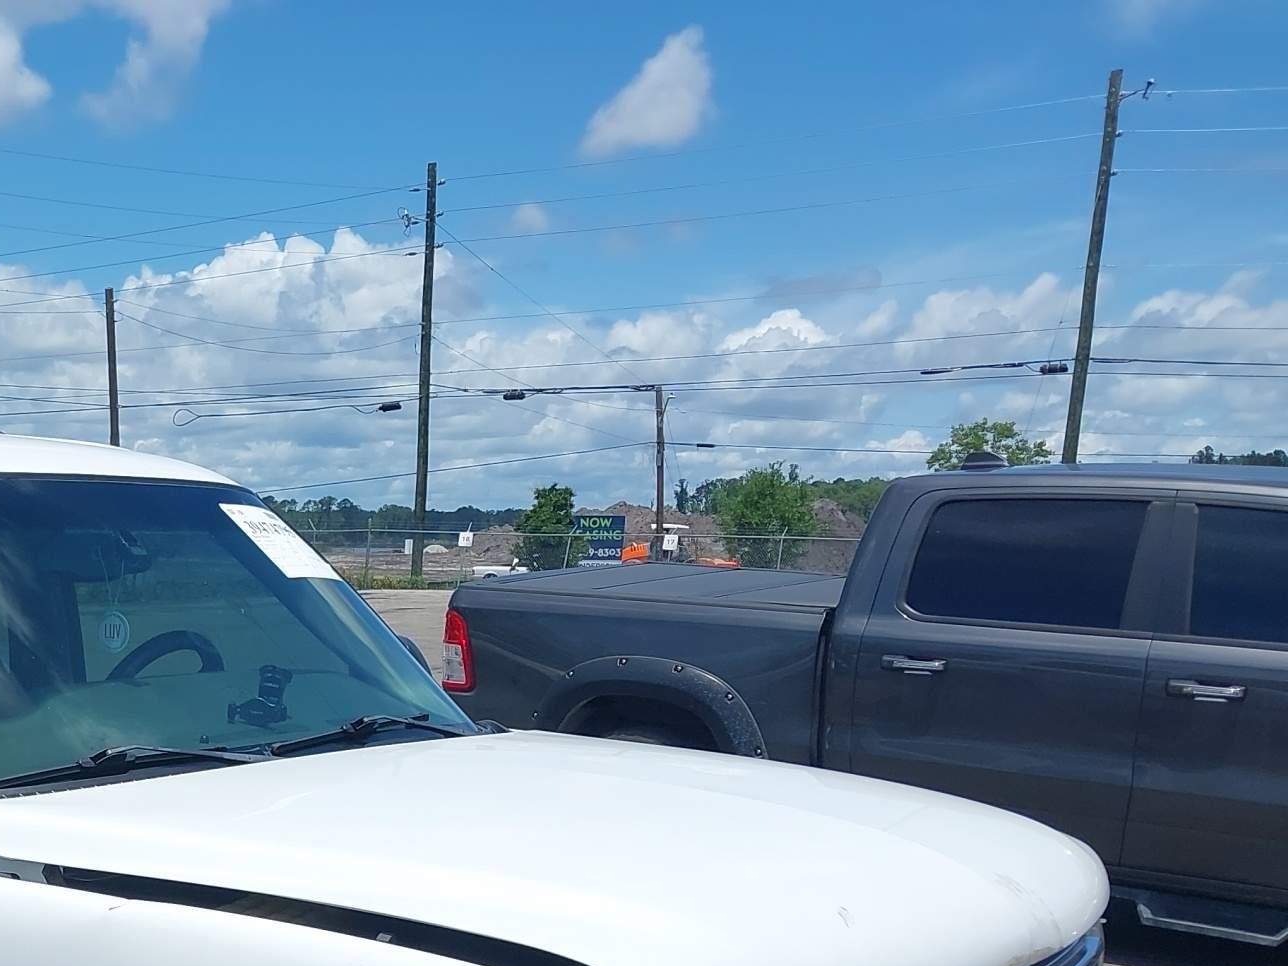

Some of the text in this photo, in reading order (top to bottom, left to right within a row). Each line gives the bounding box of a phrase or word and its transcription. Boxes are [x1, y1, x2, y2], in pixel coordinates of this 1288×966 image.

[580, 517, 612, 528] NOW
[243, 520, 296, 538] 394747
[575, 530, 623, 541] EASING
